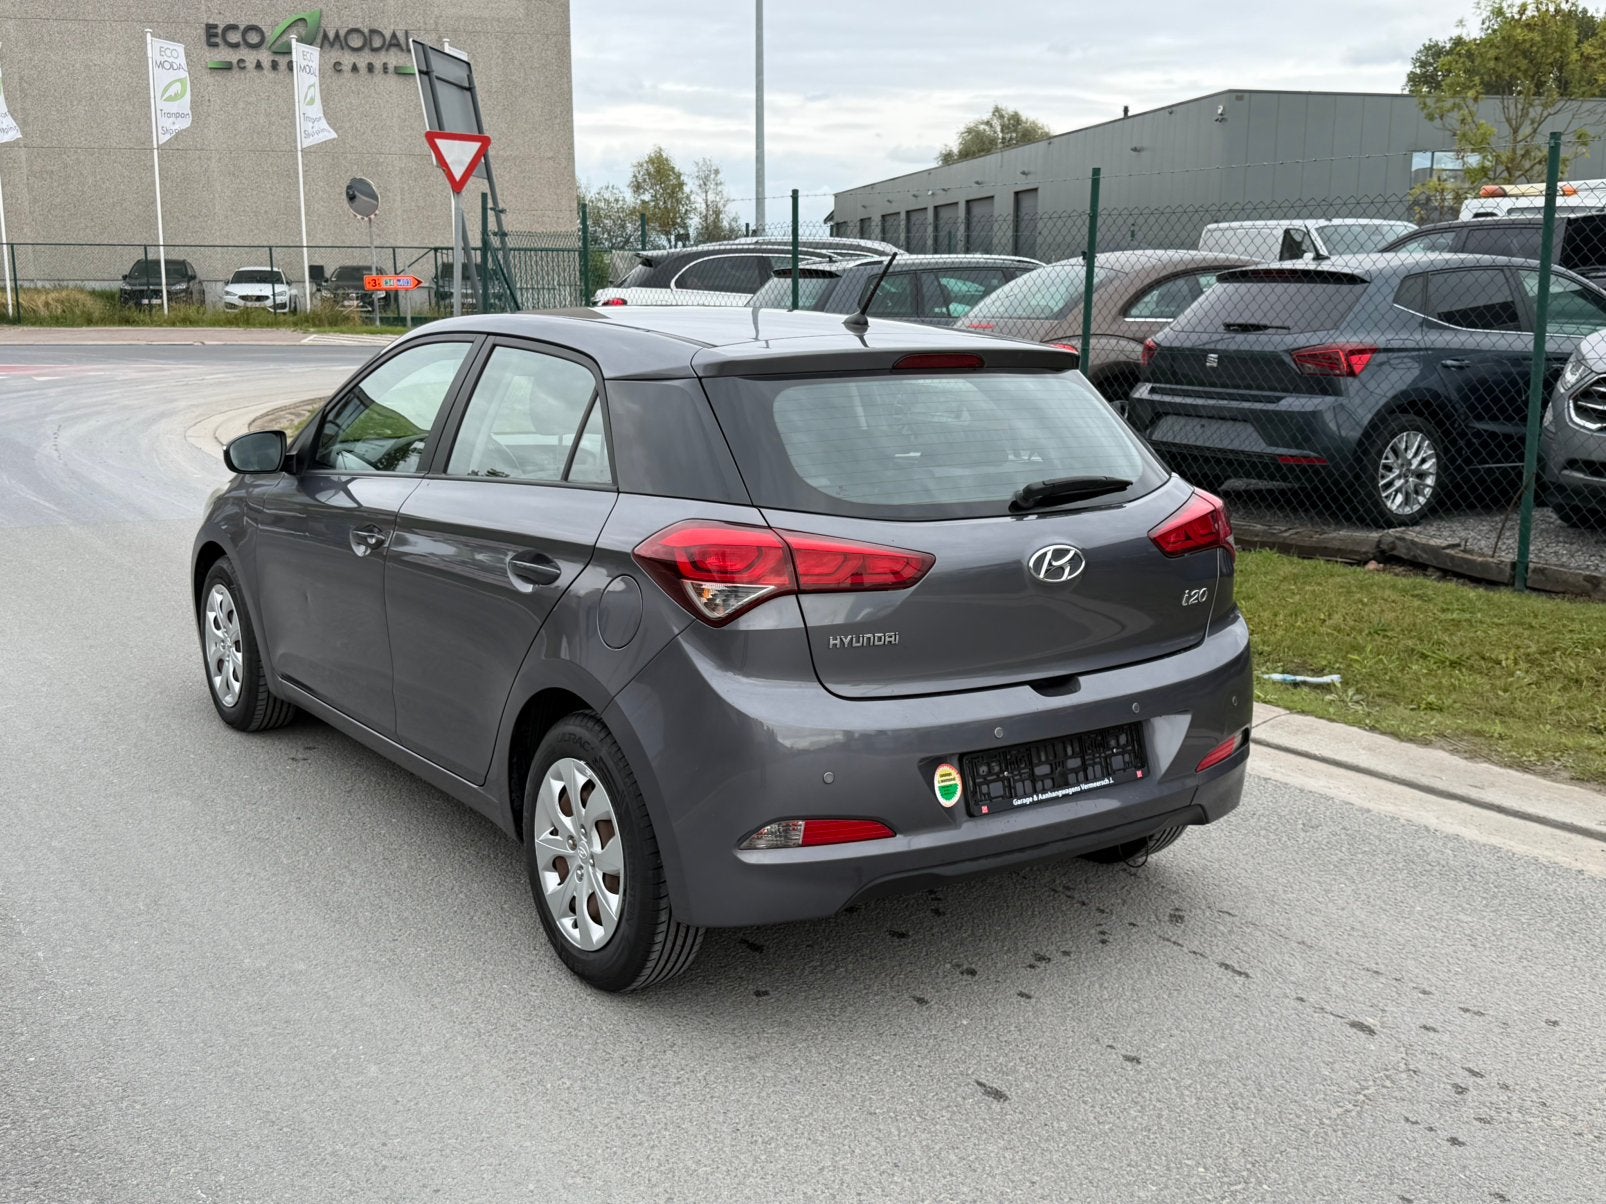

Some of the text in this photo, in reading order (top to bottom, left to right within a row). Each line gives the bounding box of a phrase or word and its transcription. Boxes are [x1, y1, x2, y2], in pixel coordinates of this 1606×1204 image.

[205, 23, 266, 49] ECO
[159, 46, 179, 59] ECO
[333, 61, 389, 74] CARE
[1182, 587, 1208, 606] i20
[829, 631, 899, 649] HYUNDAI
[1012, 796, 1033, 806] Garage
[1038, 786, 1081, 800] Aanhangwagens
[1081, 777, 1109, 790] Vermeersch
